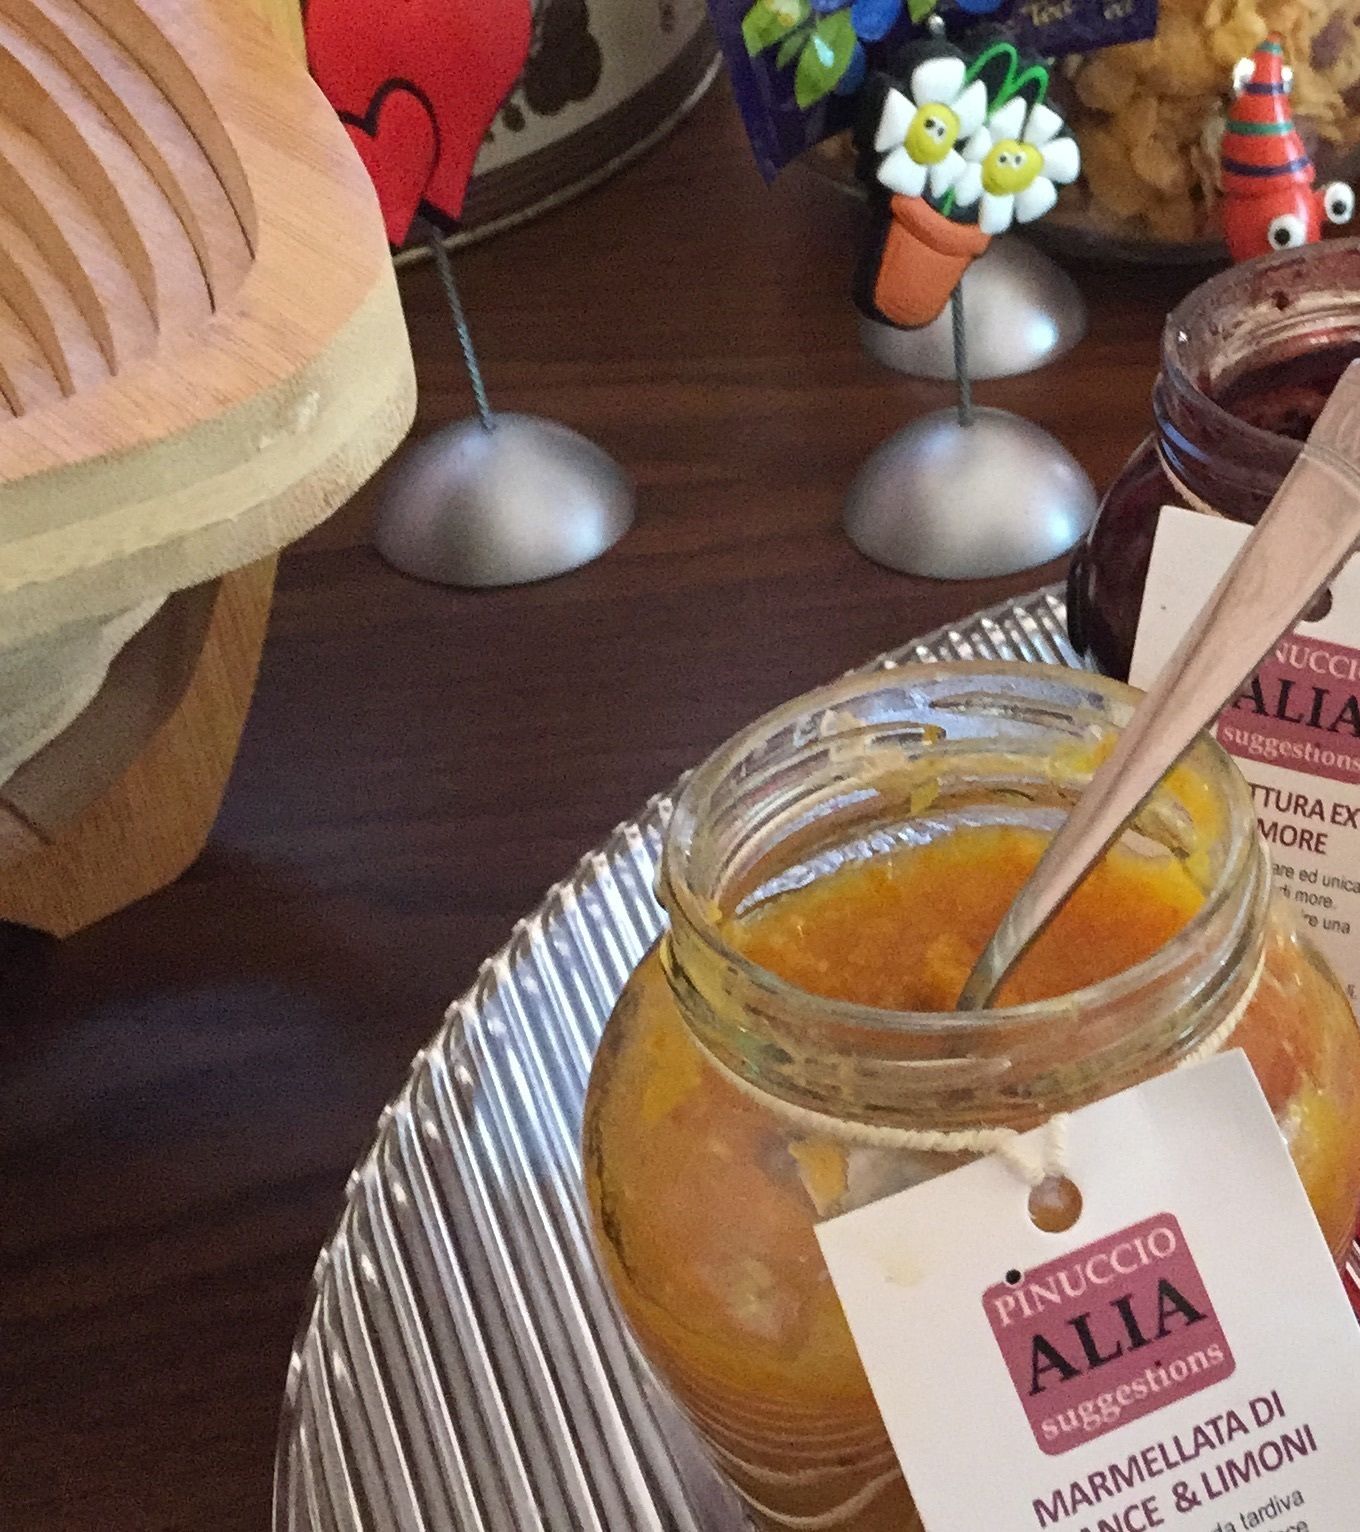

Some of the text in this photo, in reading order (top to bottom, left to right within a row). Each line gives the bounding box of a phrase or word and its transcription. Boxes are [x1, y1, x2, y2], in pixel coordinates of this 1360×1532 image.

[1248, 782, 1325, 822] TTURA
[1257, 818, 1328, 855] MORE
[1272, 862, 1295, 879] are
[1298, 868, 1318, 884] ed
[1323, 917, 1351, 934] una
[993, 1227, 1177, 1328] PINUCCIO
[1029, 1277, 1208, 1397] ALIA
[1042, 1343, 1225, 1440] suggestions
[1032, 1390, 1286, 1528] MARMELLATA DI
[1171, 1481, 1202, 1513] &
[1200, 1424, 1318, 1500] LIMONI
[1239, 1490, 1305, 1531] tardiva
